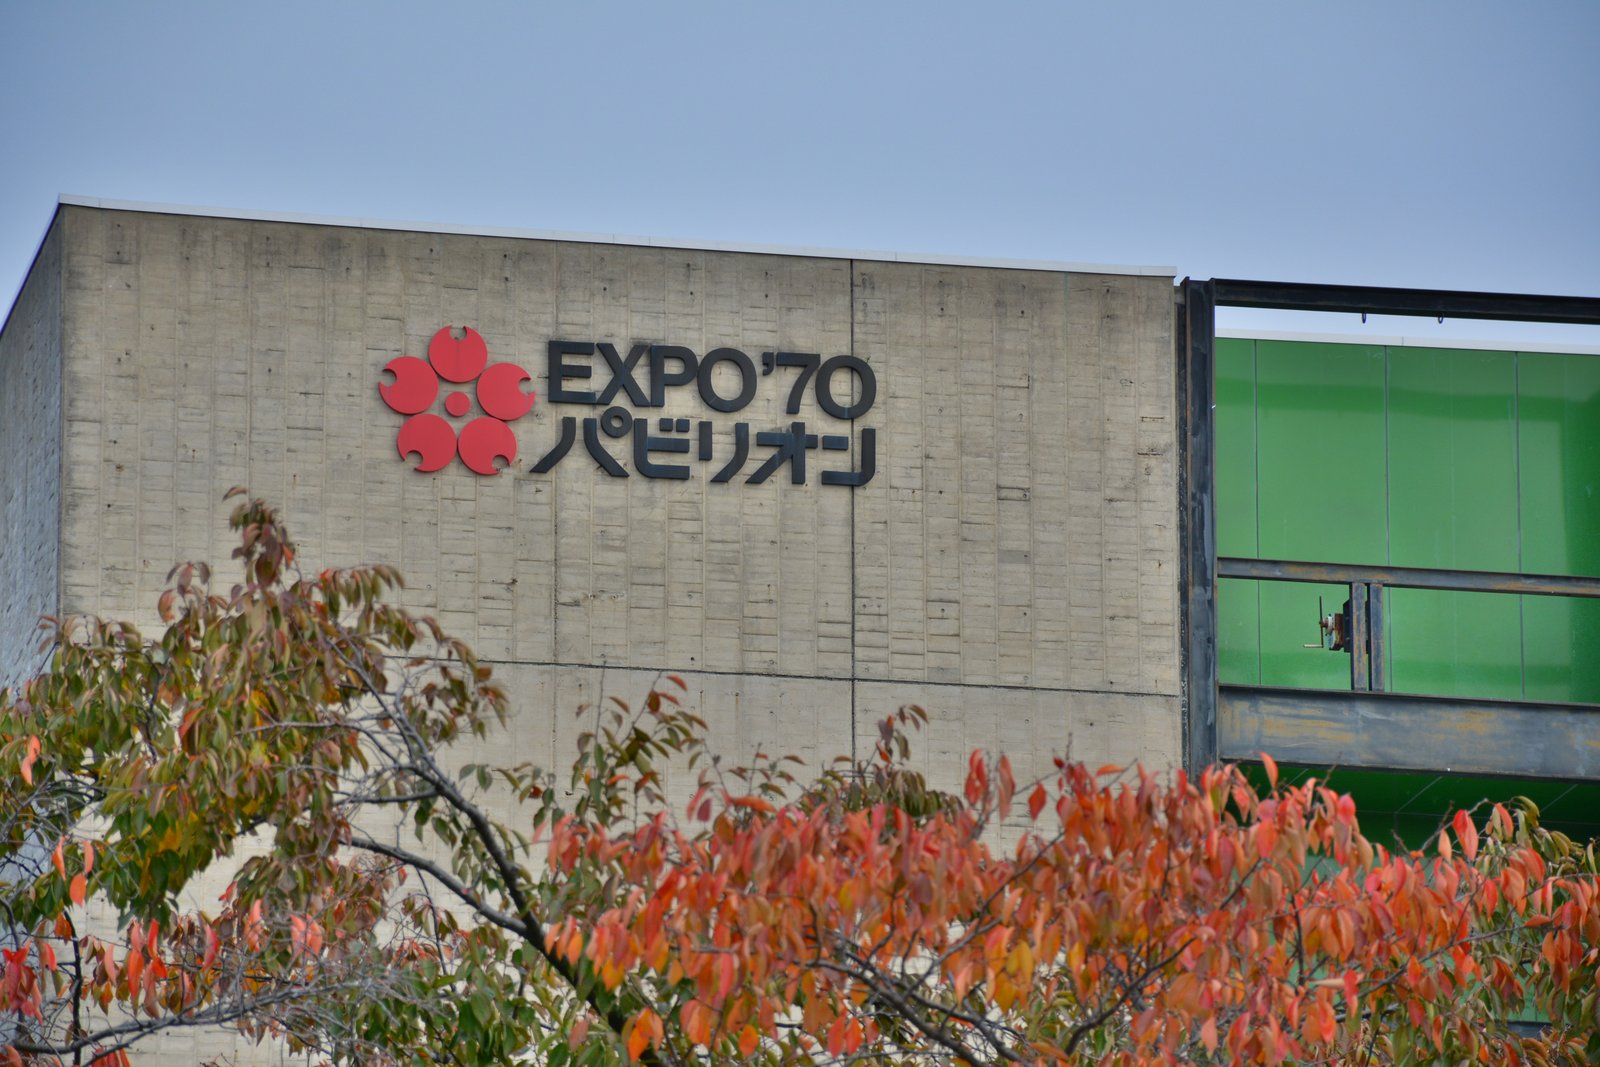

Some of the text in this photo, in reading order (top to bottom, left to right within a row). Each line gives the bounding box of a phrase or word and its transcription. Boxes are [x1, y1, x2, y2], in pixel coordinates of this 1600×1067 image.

[529, 405, 877, 486] パビリオン
